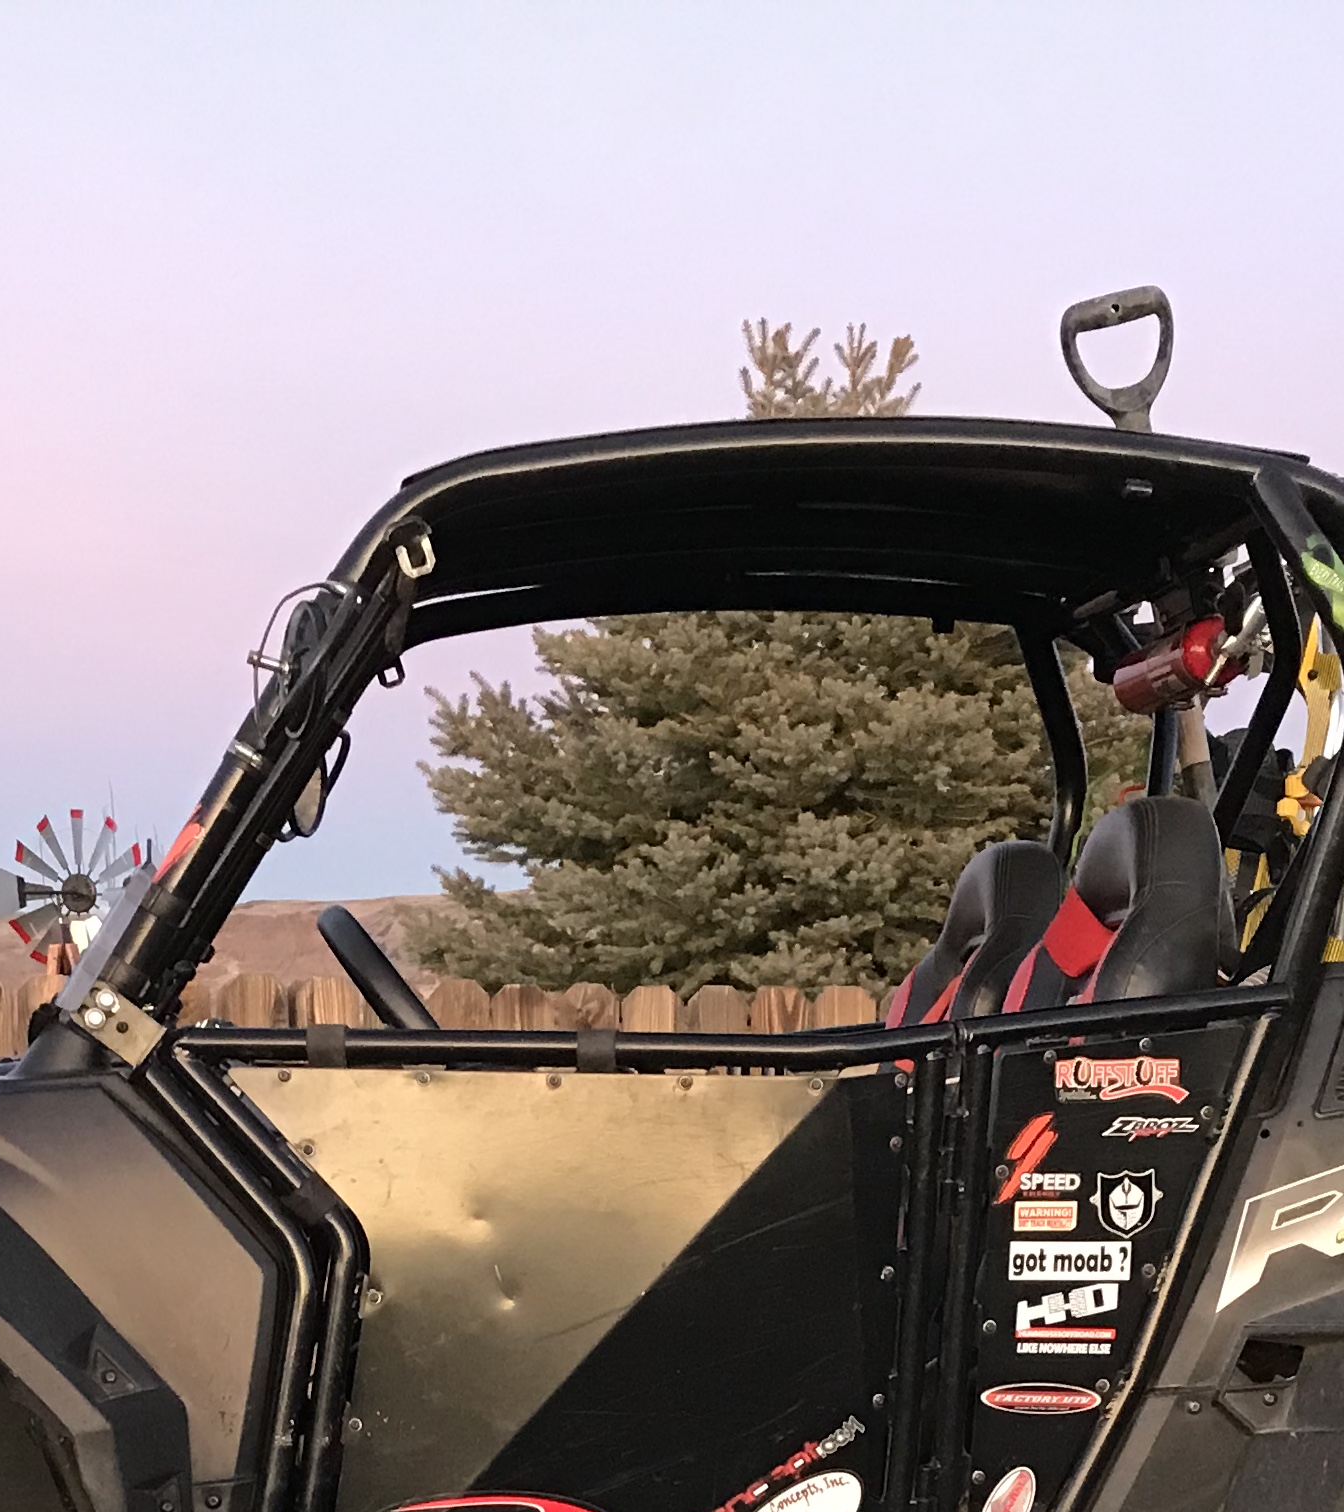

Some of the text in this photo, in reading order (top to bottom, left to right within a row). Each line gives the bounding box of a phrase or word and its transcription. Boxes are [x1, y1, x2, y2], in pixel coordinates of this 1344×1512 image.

[1020, 1173, 1081, 1190] SPEED
[1019, 1208, 1073, 1218] WARNING!
[1012, 1245, 1129, 1276] got moab ?
[1016, 1343, 1112, 1354] LIKE NOWHERE ELSE
[994, 1393, 1092, 1404] FACTORY UTV
[822, 1475, 850, 1489] Inc.
